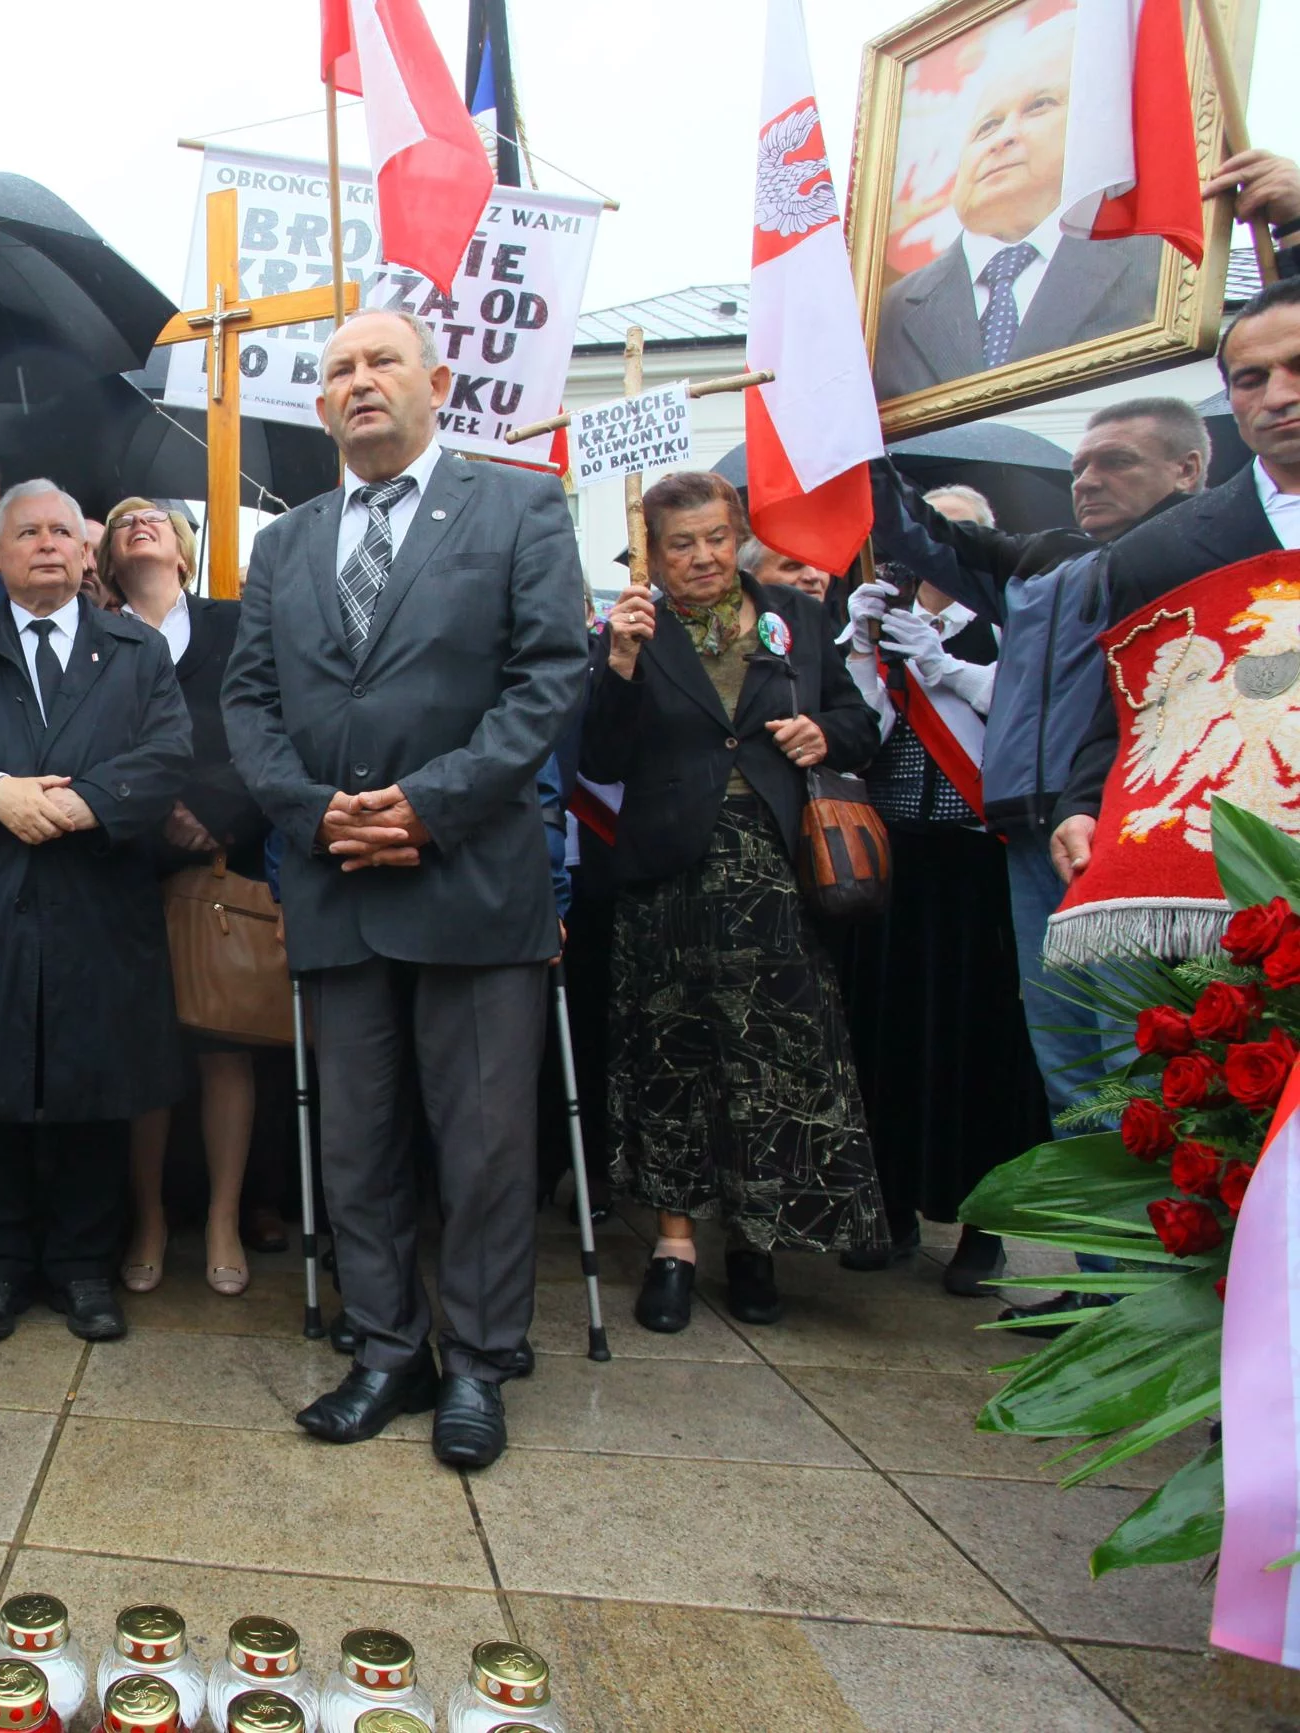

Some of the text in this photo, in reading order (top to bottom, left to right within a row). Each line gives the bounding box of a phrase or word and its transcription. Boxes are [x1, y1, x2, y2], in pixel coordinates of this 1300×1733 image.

[487, 206, 503, 223] Z
[512, 208, 582, 235] WAMI
[480, 288, 549, 330] OD
[578, 404, 686, 450] KRZYŻA OD
[582, 391, 676, 430] BROŃCIE
[580, 436, 689, 478] DO BAŁTYKU
[586, 420, 680, 460] GIEWONTU
[625, 463, 644, 473] JAN
[649, 455, 679, 468] PAWEŁ
